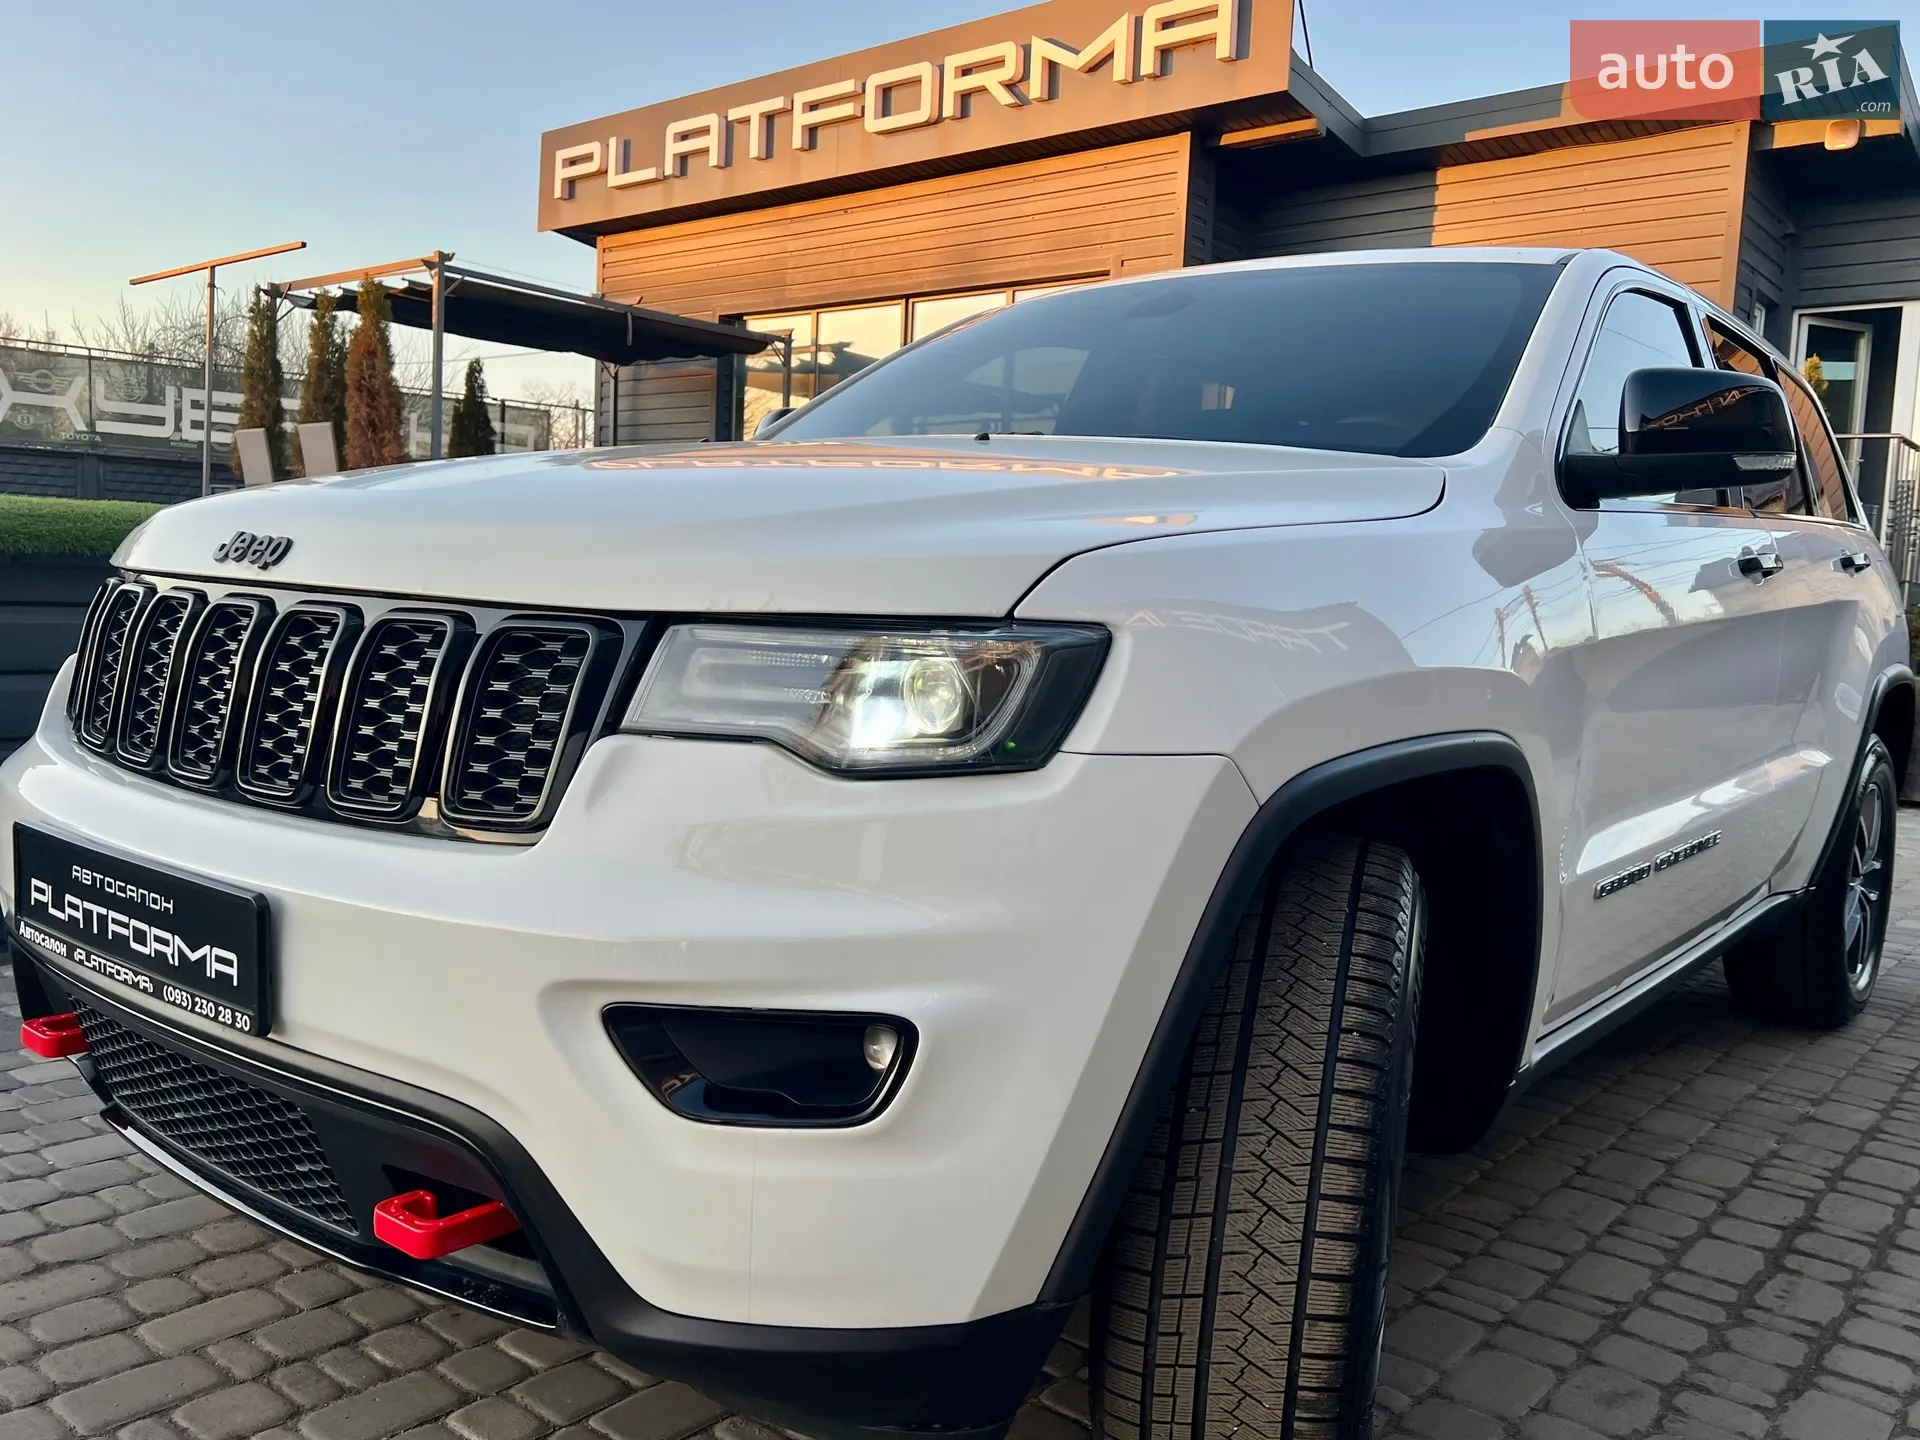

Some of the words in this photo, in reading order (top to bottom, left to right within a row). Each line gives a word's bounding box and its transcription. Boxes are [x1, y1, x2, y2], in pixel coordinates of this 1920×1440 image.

[553, 0, 1236, 200] PLATFORMA
[61, 432, 102, 442] TOYOTA
[212, 531, 293, 570] Jeep
[19, 920, 67, 957] Автосалон
[163, 985, 192, 1011] (093)
[194, 997, 215, 1018] 230
[218, 1006, 232, 1025] 28
[235, 1012, 251, 1031] 30
[31, 878, 238, 987] PLATFORMA
